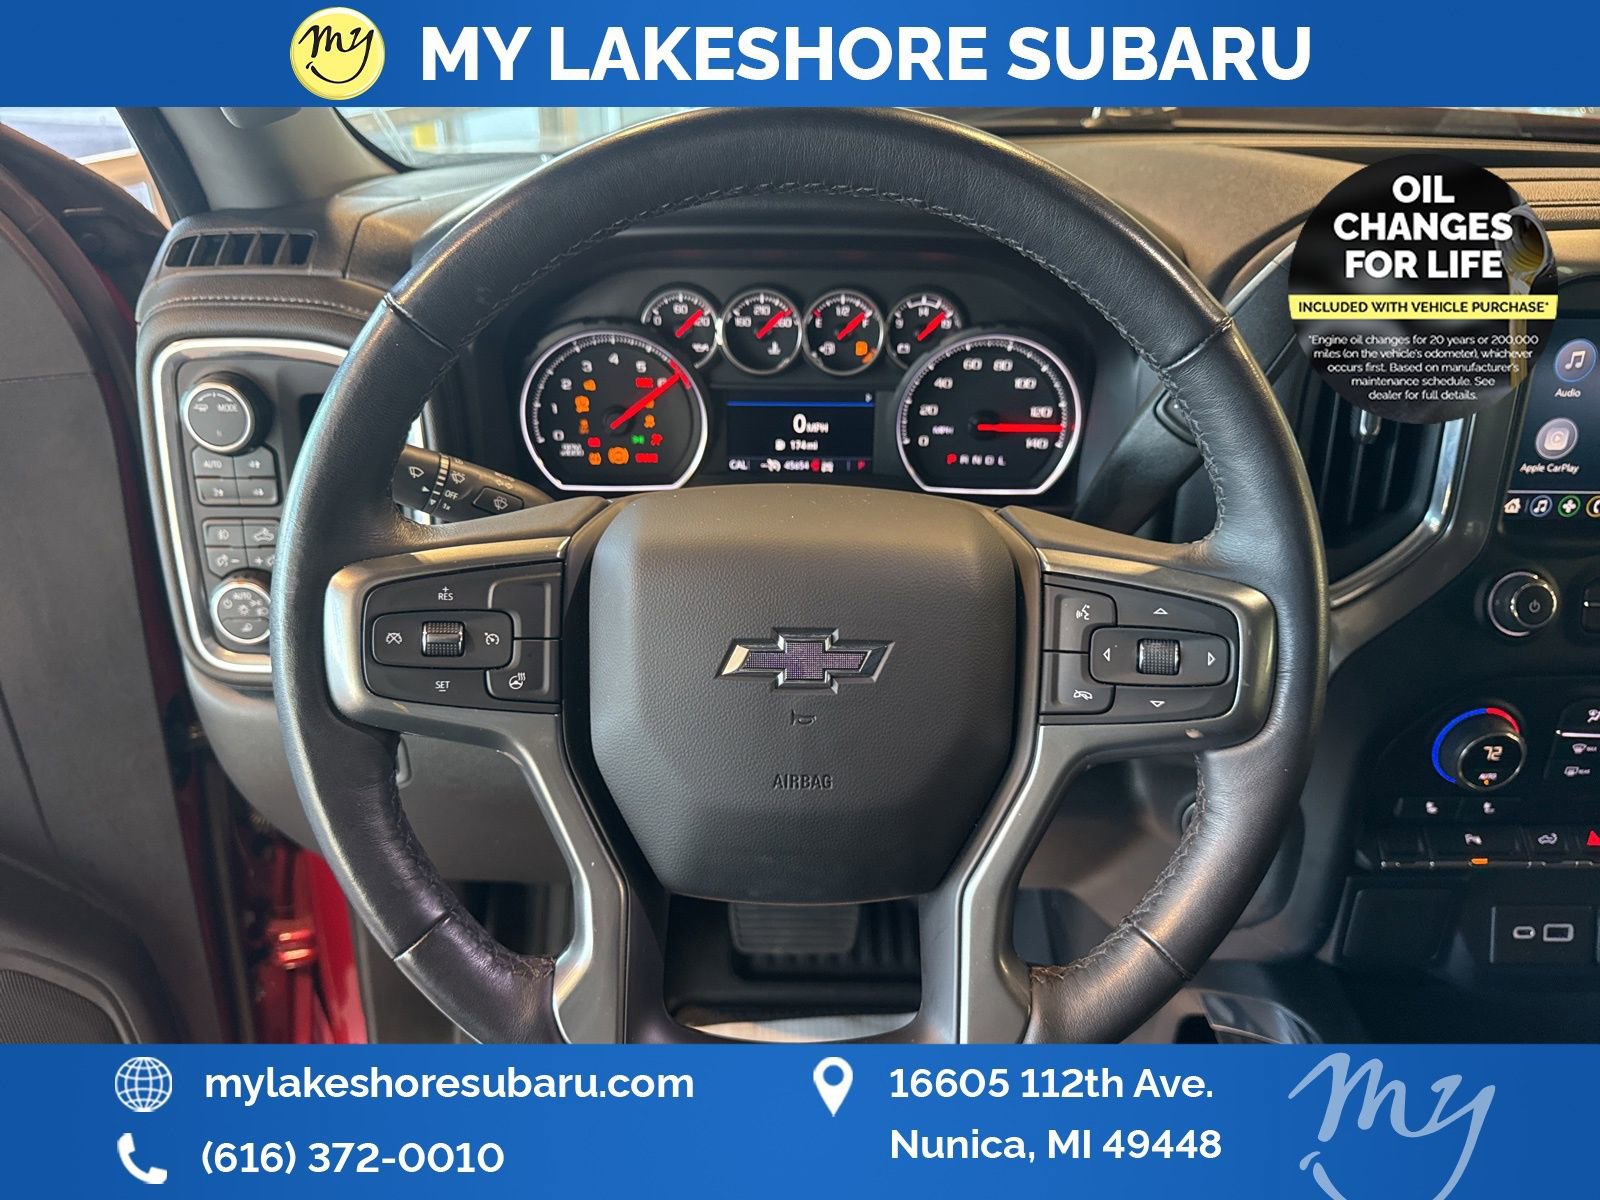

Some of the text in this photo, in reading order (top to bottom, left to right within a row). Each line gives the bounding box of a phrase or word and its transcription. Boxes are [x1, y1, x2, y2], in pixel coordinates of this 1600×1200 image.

[652, 315, 662, 326] 0
[815, 317, 823, 329] E
[862, 319, 870, 329] F
[608, 352, 619, 365] 4
[963, 357, 982, 371] 60
[993, 357, 1013, 372] 80
[581, 360, 593, 373] 3
[635, 361, 647, 373] 5
[560, 378, 572, 391] 2
[933, 375, 953, 389] 40
[1014, 375, 1037, 390] 100
[1554, 387, 1581, 398] Audio
[217, 403, 238, 412] MODE
[551, 402, 558, 414] 1
[919, 404, 939, 416] 20
[1029, 405, 1053, 418] 120
[792, 413, 829, 433] 0 MPH
[552, 429, 565, 441] 0
[932, 425, 954, 435] MPH
[917, 435, 929, 447] 0
[1025, 437, 1049, 450] 140
[203, 460, 223, 469] AUTO
[729, 458, 748, 471] CAL
[946, 454, 957, 464] P
[972, 454, 982, 465] N
[984, 454, 994, 465] D
[997, 455, 1006, 466] L
[1519, 462, 1580, 473] Apple CarPlay
[444, 489, 459, 500] OFF
[233, 591, 252, 599] AUTO
[438, 592, 454, 601] RES
[435, 680, 451, 690] SET
[1483, 745, 1503, 761] 72
[773, 774, 833, 790] AIRBAG
[1478, 772, 1497, 780] AUTO
